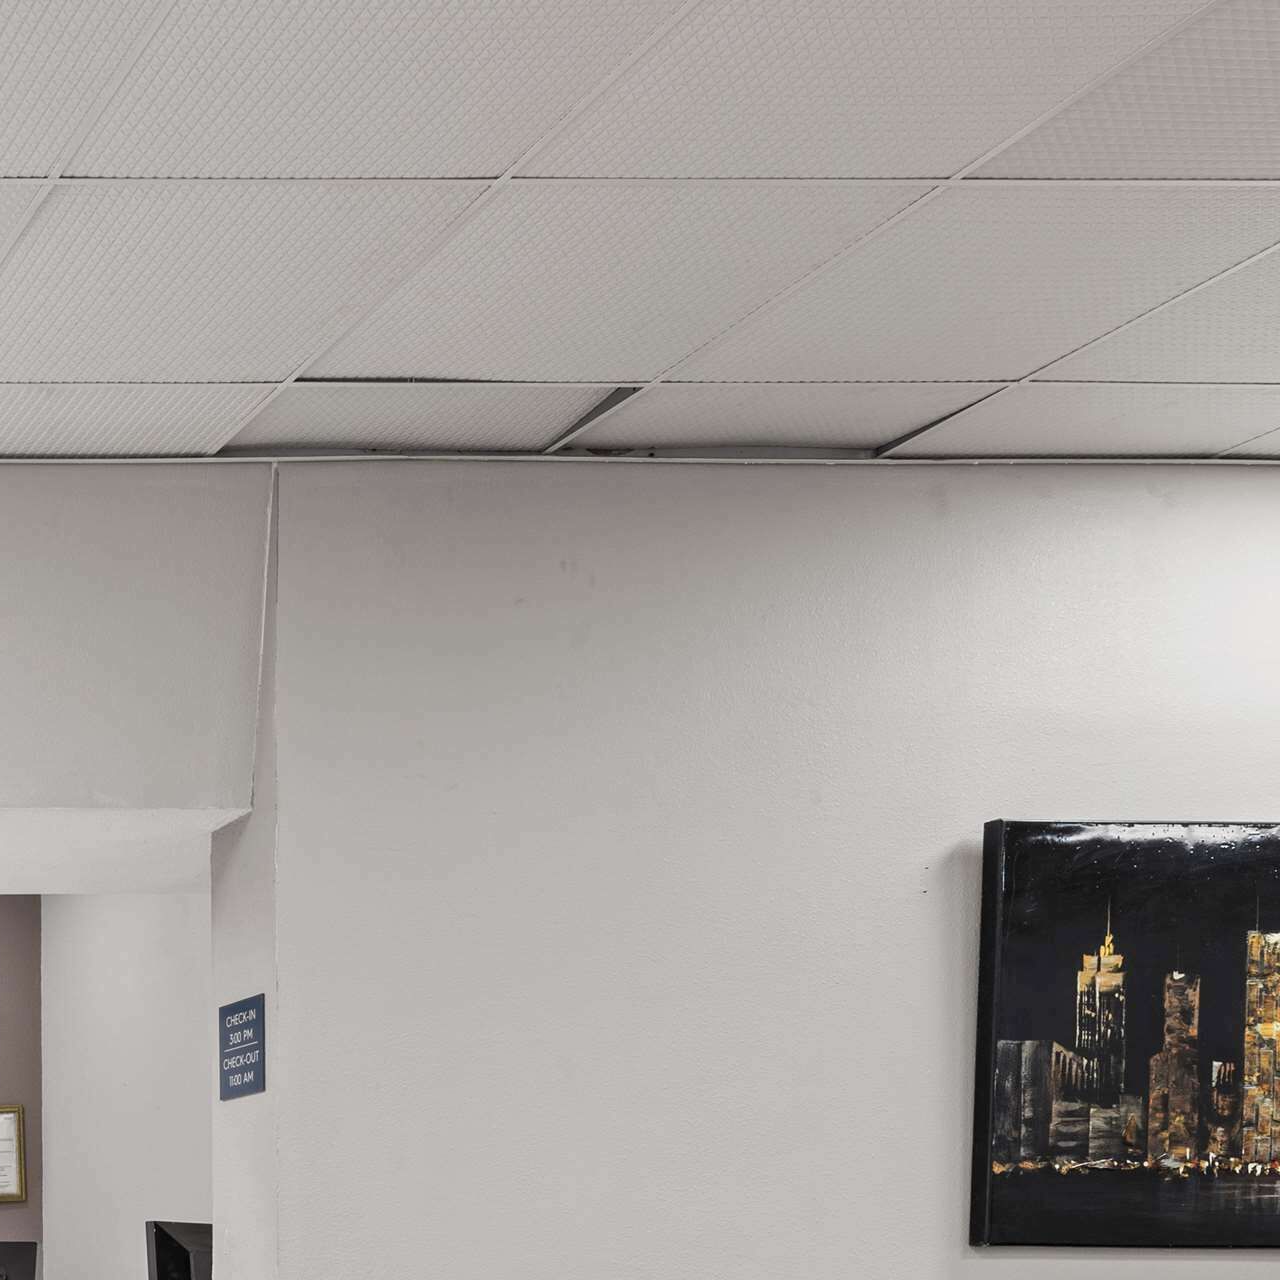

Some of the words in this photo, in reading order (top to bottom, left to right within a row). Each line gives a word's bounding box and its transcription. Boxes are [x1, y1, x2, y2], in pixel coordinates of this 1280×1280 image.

[225, 1009, 256, 1028] CHECK-IN
[243, 1028, 254, 1041] PM
[223, 1050, 260, 1071] CHECK-OUT
[243, 1072, 254, 1085] AM
